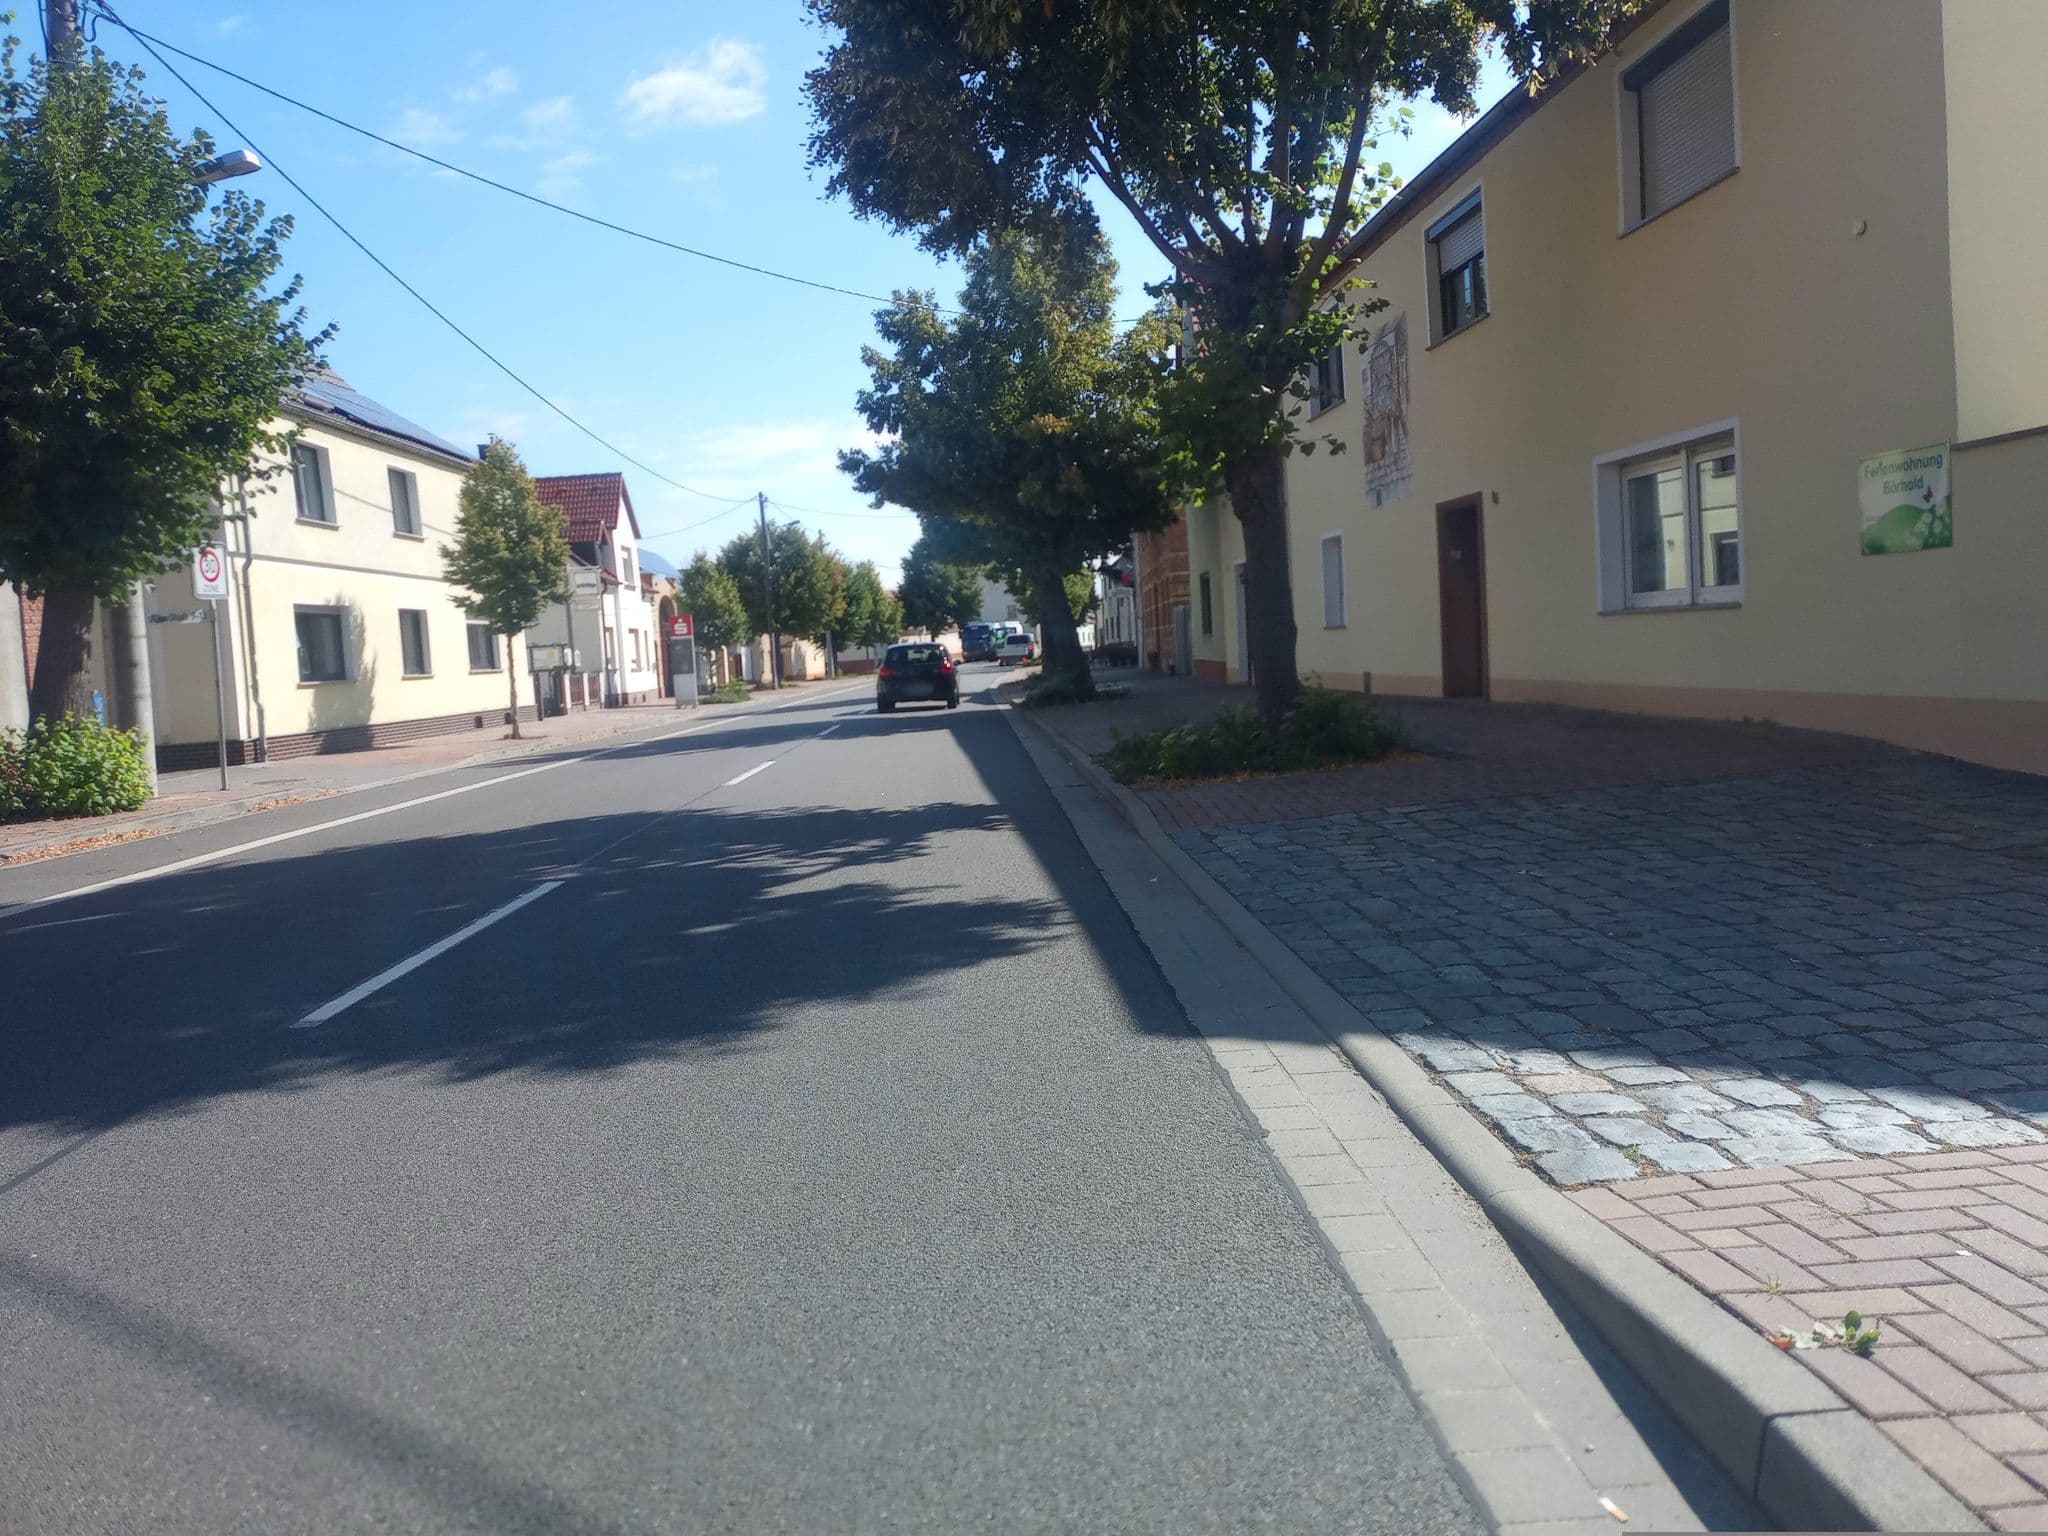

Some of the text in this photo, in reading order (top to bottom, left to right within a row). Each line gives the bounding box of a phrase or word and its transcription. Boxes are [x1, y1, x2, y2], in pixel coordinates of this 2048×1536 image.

[1864, 454, 1943, 479] Ferienwohnung
[203, 558, 216, 574] 30
[203, 583, 220, 593] ZONE
